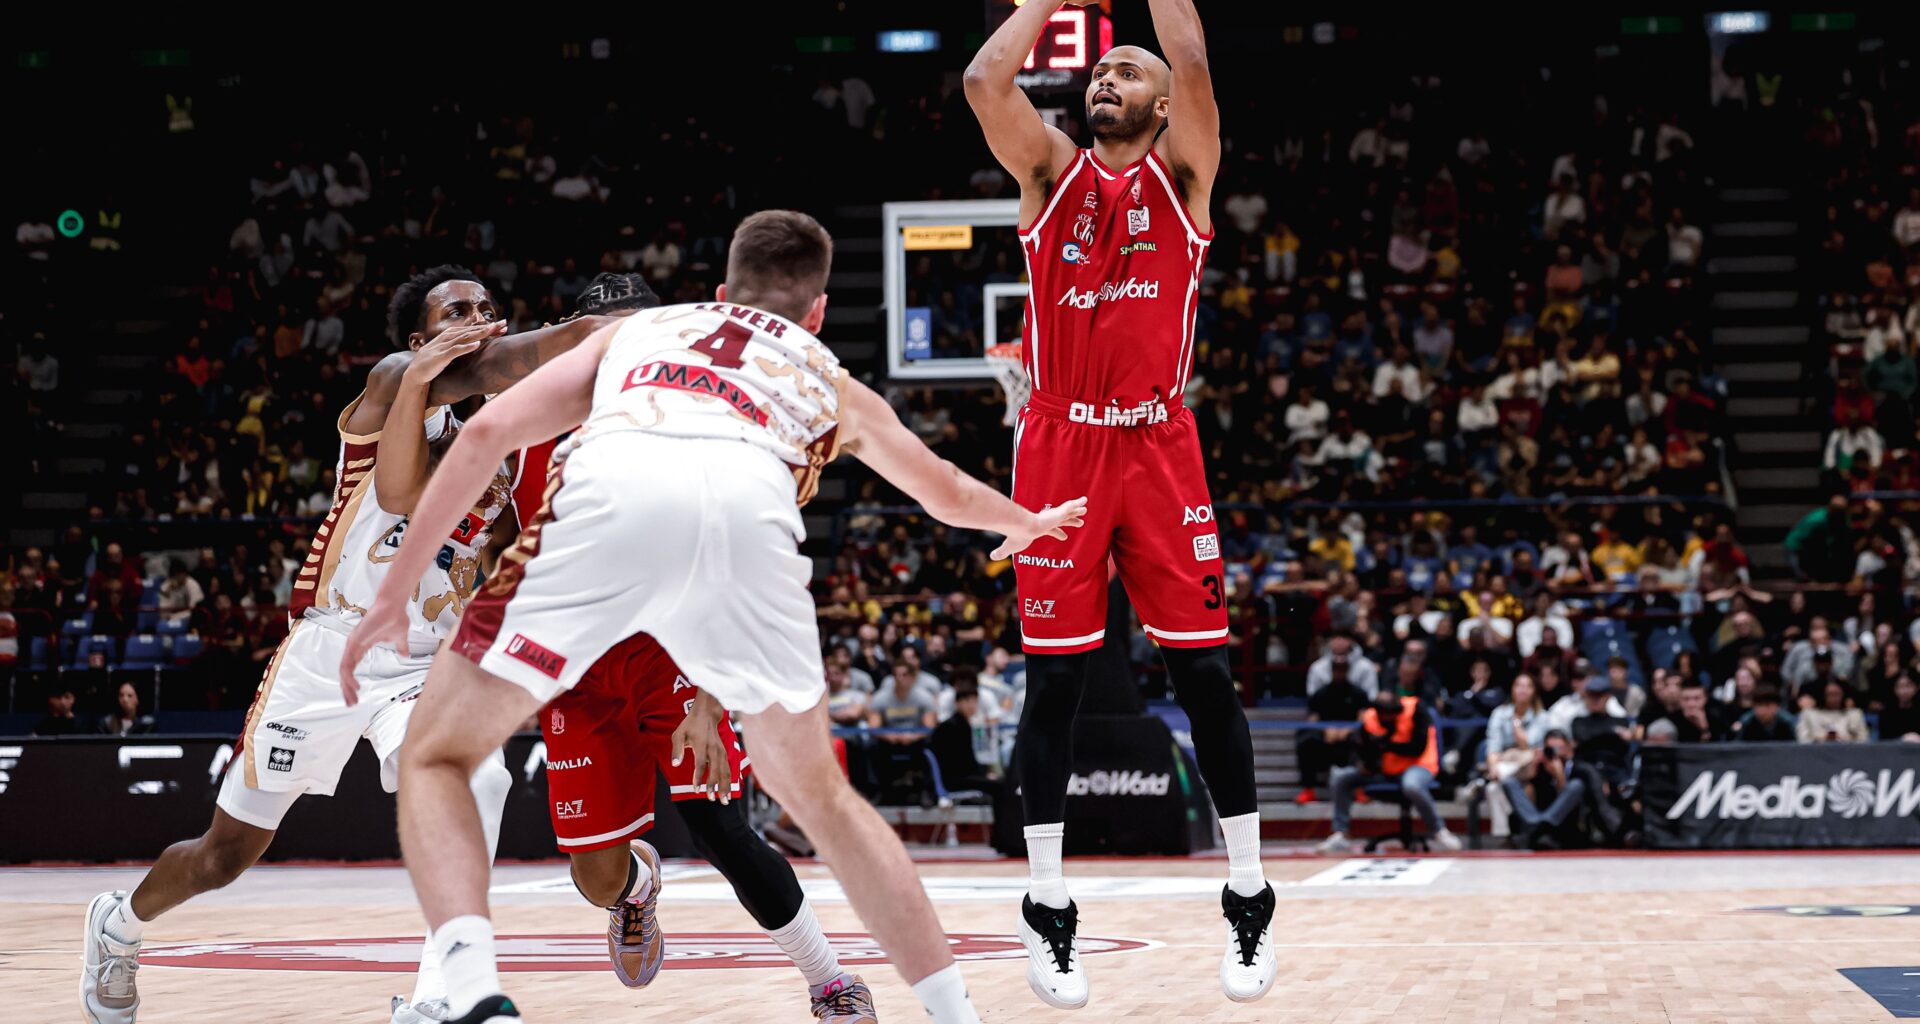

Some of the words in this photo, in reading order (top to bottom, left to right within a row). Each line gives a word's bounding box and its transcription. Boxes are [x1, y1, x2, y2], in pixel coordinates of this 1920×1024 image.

[688, 319, 754, 370] 4
[1068, 401, 1169, 427] OLIMPIA
[1018, 554, 1075, 569] DRIVALIA
[1024, 598, 1056, 614] EA7
[1665, 769, 1828, 820] Media
[556, 799, 583, 816] EA7
